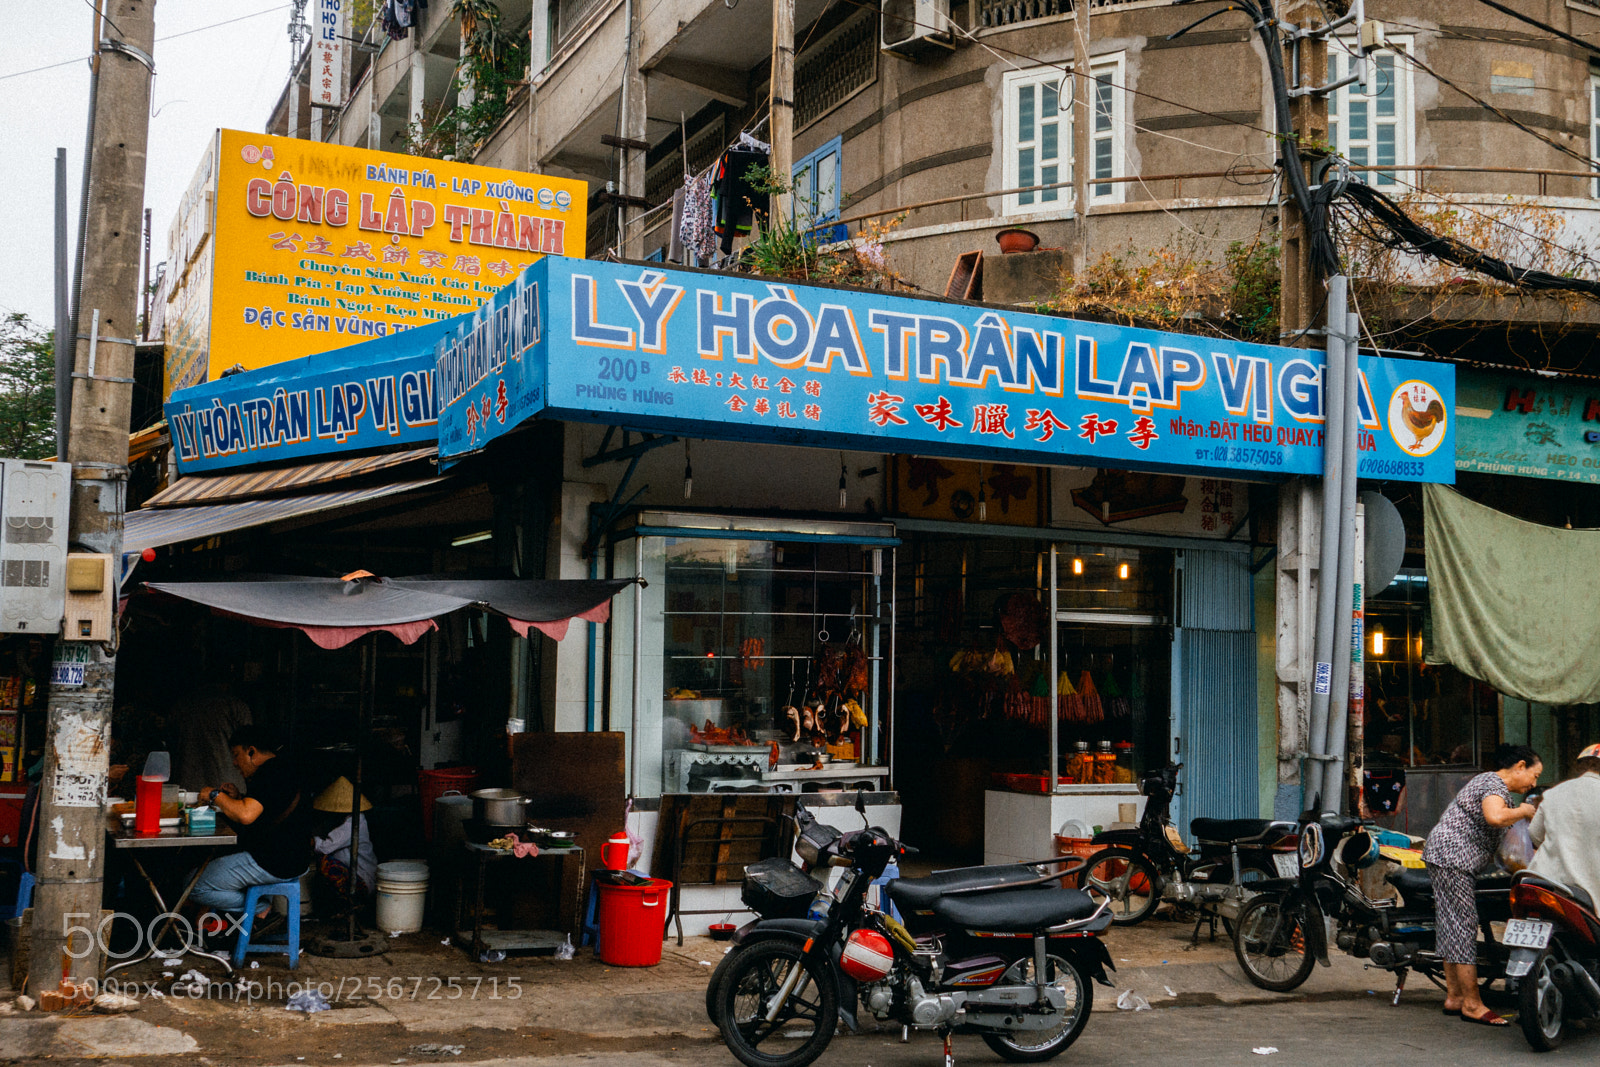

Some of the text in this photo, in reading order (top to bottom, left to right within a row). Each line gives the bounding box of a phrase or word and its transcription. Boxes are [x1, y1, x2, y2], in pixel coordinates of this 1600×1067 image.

[322, 26, 336, 41] LÊ
[366, 163, 408, 185] BÁNH
[412, 169, 437, 189] PÍA
[452, 176, 481, 197] LẠP
[485, 179, 534, 203] XƯỞNG
[247, 171, 566, 255] CÔNG LẬP THÀNH
[245, 270, 290, 286] Bánh
[294, 276, 322, 289] Pía
[334, 280, 365, 296] Lạp
[431, 291, 472, 306] Bánh
[299, 259, 362, 276] Chuyên
[365, 267, 395, 280] Sản
[398, 271, 437, 286] Xuất
[441, 276, 469, 290] Các
[287, 292, 331, 308] Bánh
[335, 298, 373, 314] Ngọt
[385, 304, 417, 319] Kẹo
[243, 306, 286, 329] ĐẶC
[291, 308, 330, 332] SẢN
[334, 315, 388, 337] VŨNG
[571, 270, 686, 355] LÝ
[696, 284, 873, 377] HÒA
[868, 308, 1065, 398] TRÂN
[1075, 335, 1207, 416] LẠP
[1211, 352, 1273, 425] VỊ
[575, 382, 674, 406] PHÙNG HƯNG
[172, 404, 200, 462] LÝ
[196, 398, 248, 458] HÒA
[242, 387, 311, 451] TRÂN
[314, 381, 367, 444] LẠP
[366, 375, 401, 437] VỊ
[1243, 423, 1272, 443] HEO
[1356, 428, 1377, 452] ỮA
[1477, 460, 1515, 473] PHÙNG
[1518, 465, 1548, 476] HƯNG
[1546, 453, 1577, 466] HEO
[1505, 932, 1545, 946] 212.78
[1513, 921, 1543, 934] 59-L1
